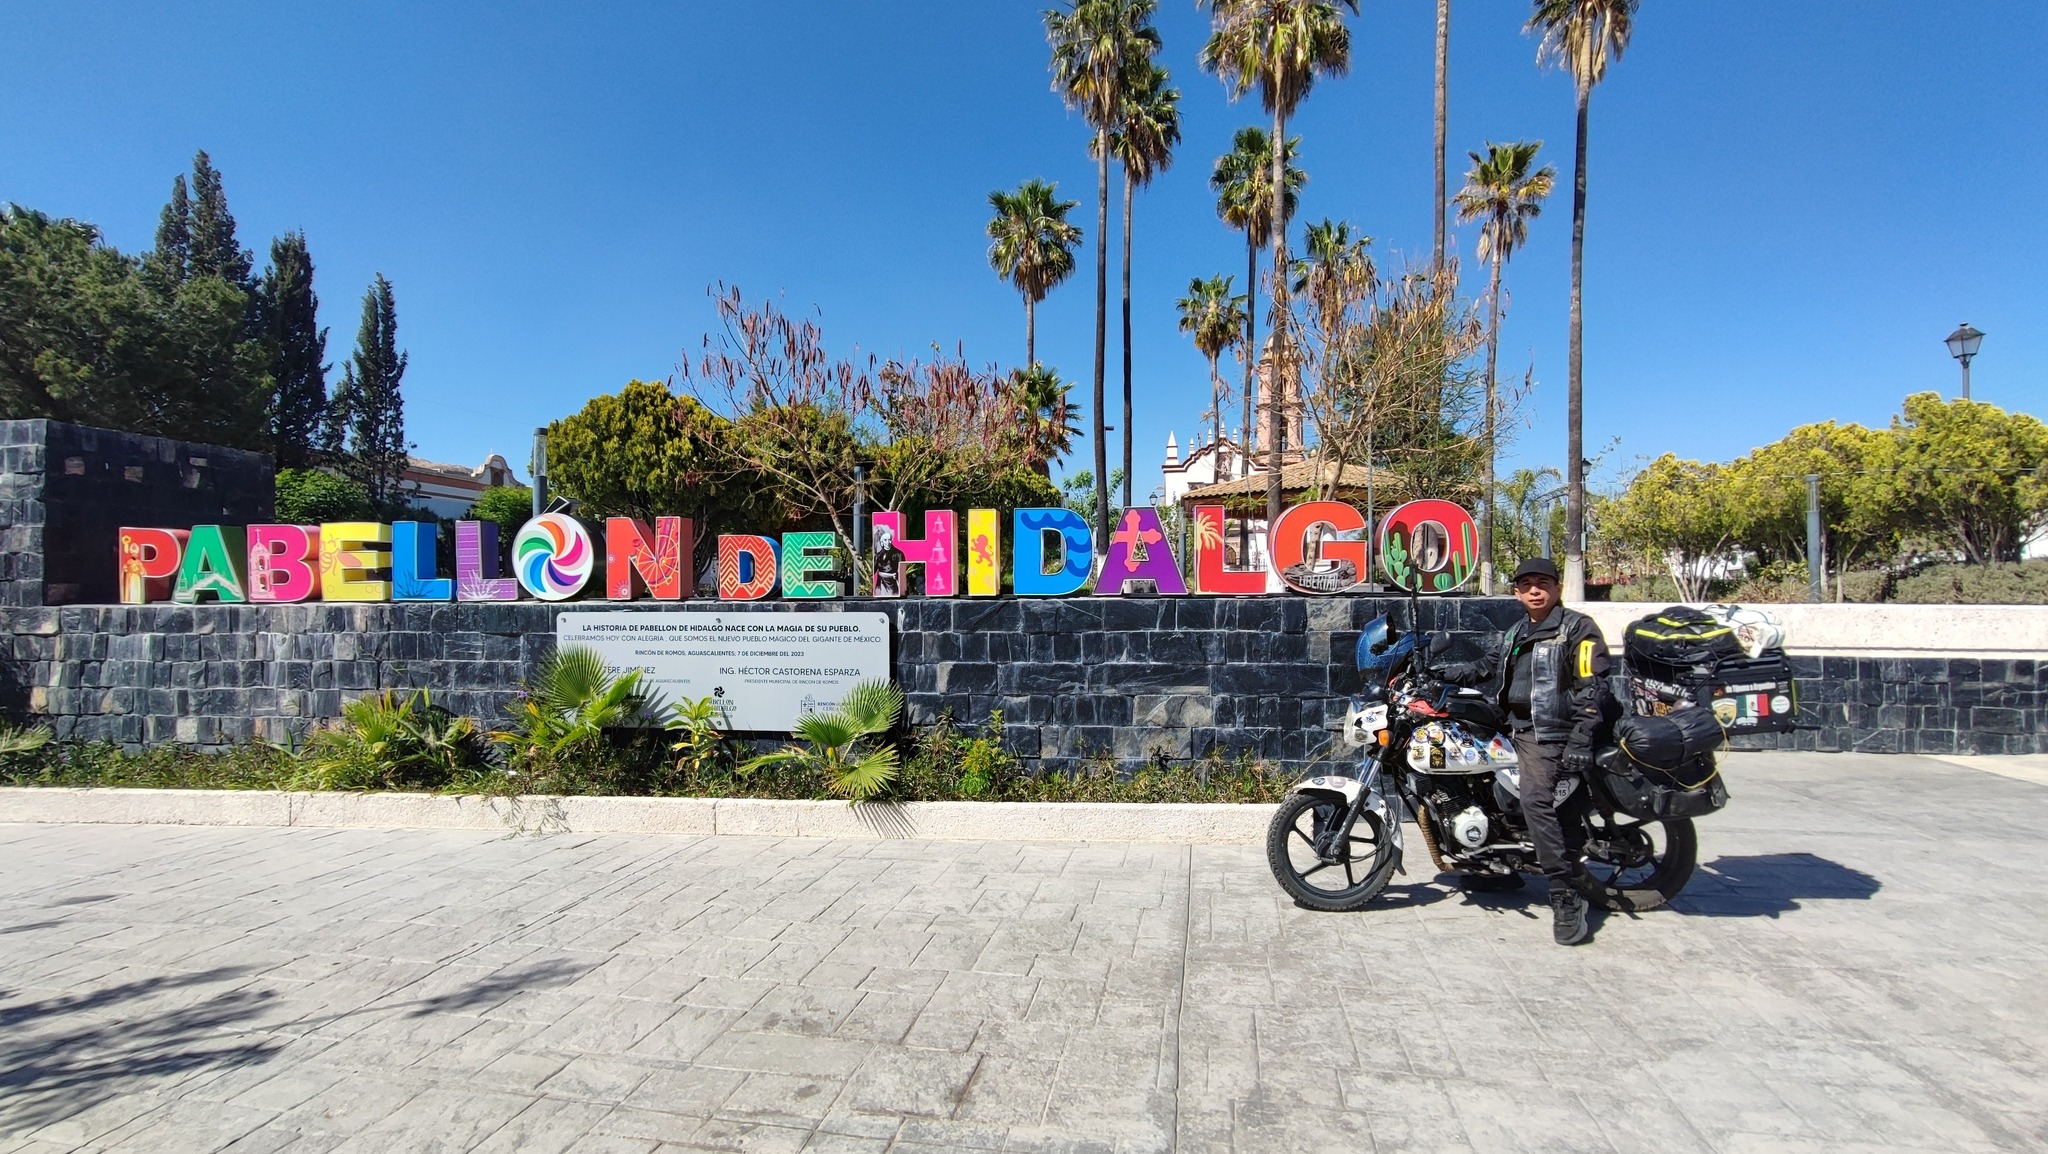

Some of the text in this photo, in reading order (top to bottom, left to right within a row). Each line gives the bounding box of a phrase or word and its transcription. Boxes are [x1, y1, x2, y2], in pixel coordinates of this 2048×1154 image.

[119, 496, 1480, 604] PABELLÓN DE HIDALGO
[582, 624, 592, 632] LA
[593, 624, 628, 632] HISTORIA
[628, 624, 639, 632] DE
[640, 624, 677, 632] PABELLON
[678, 624, 689, 632] DE
[690, 624, 724, 632] HIDALGO
[776, 625, 804, 633] MAGIA
[804, 625, 815, 633] DE
[816, 625, 828, 633] SU
[563, 634, 605, 642] CELEBRAMOS
[717, 635, 741, 643] NUEVO
[742, 635, 768, 643] PUEBLO
[719, 666, 861, 677] ING. HÉCTOR CASTORENA ESPARZA
